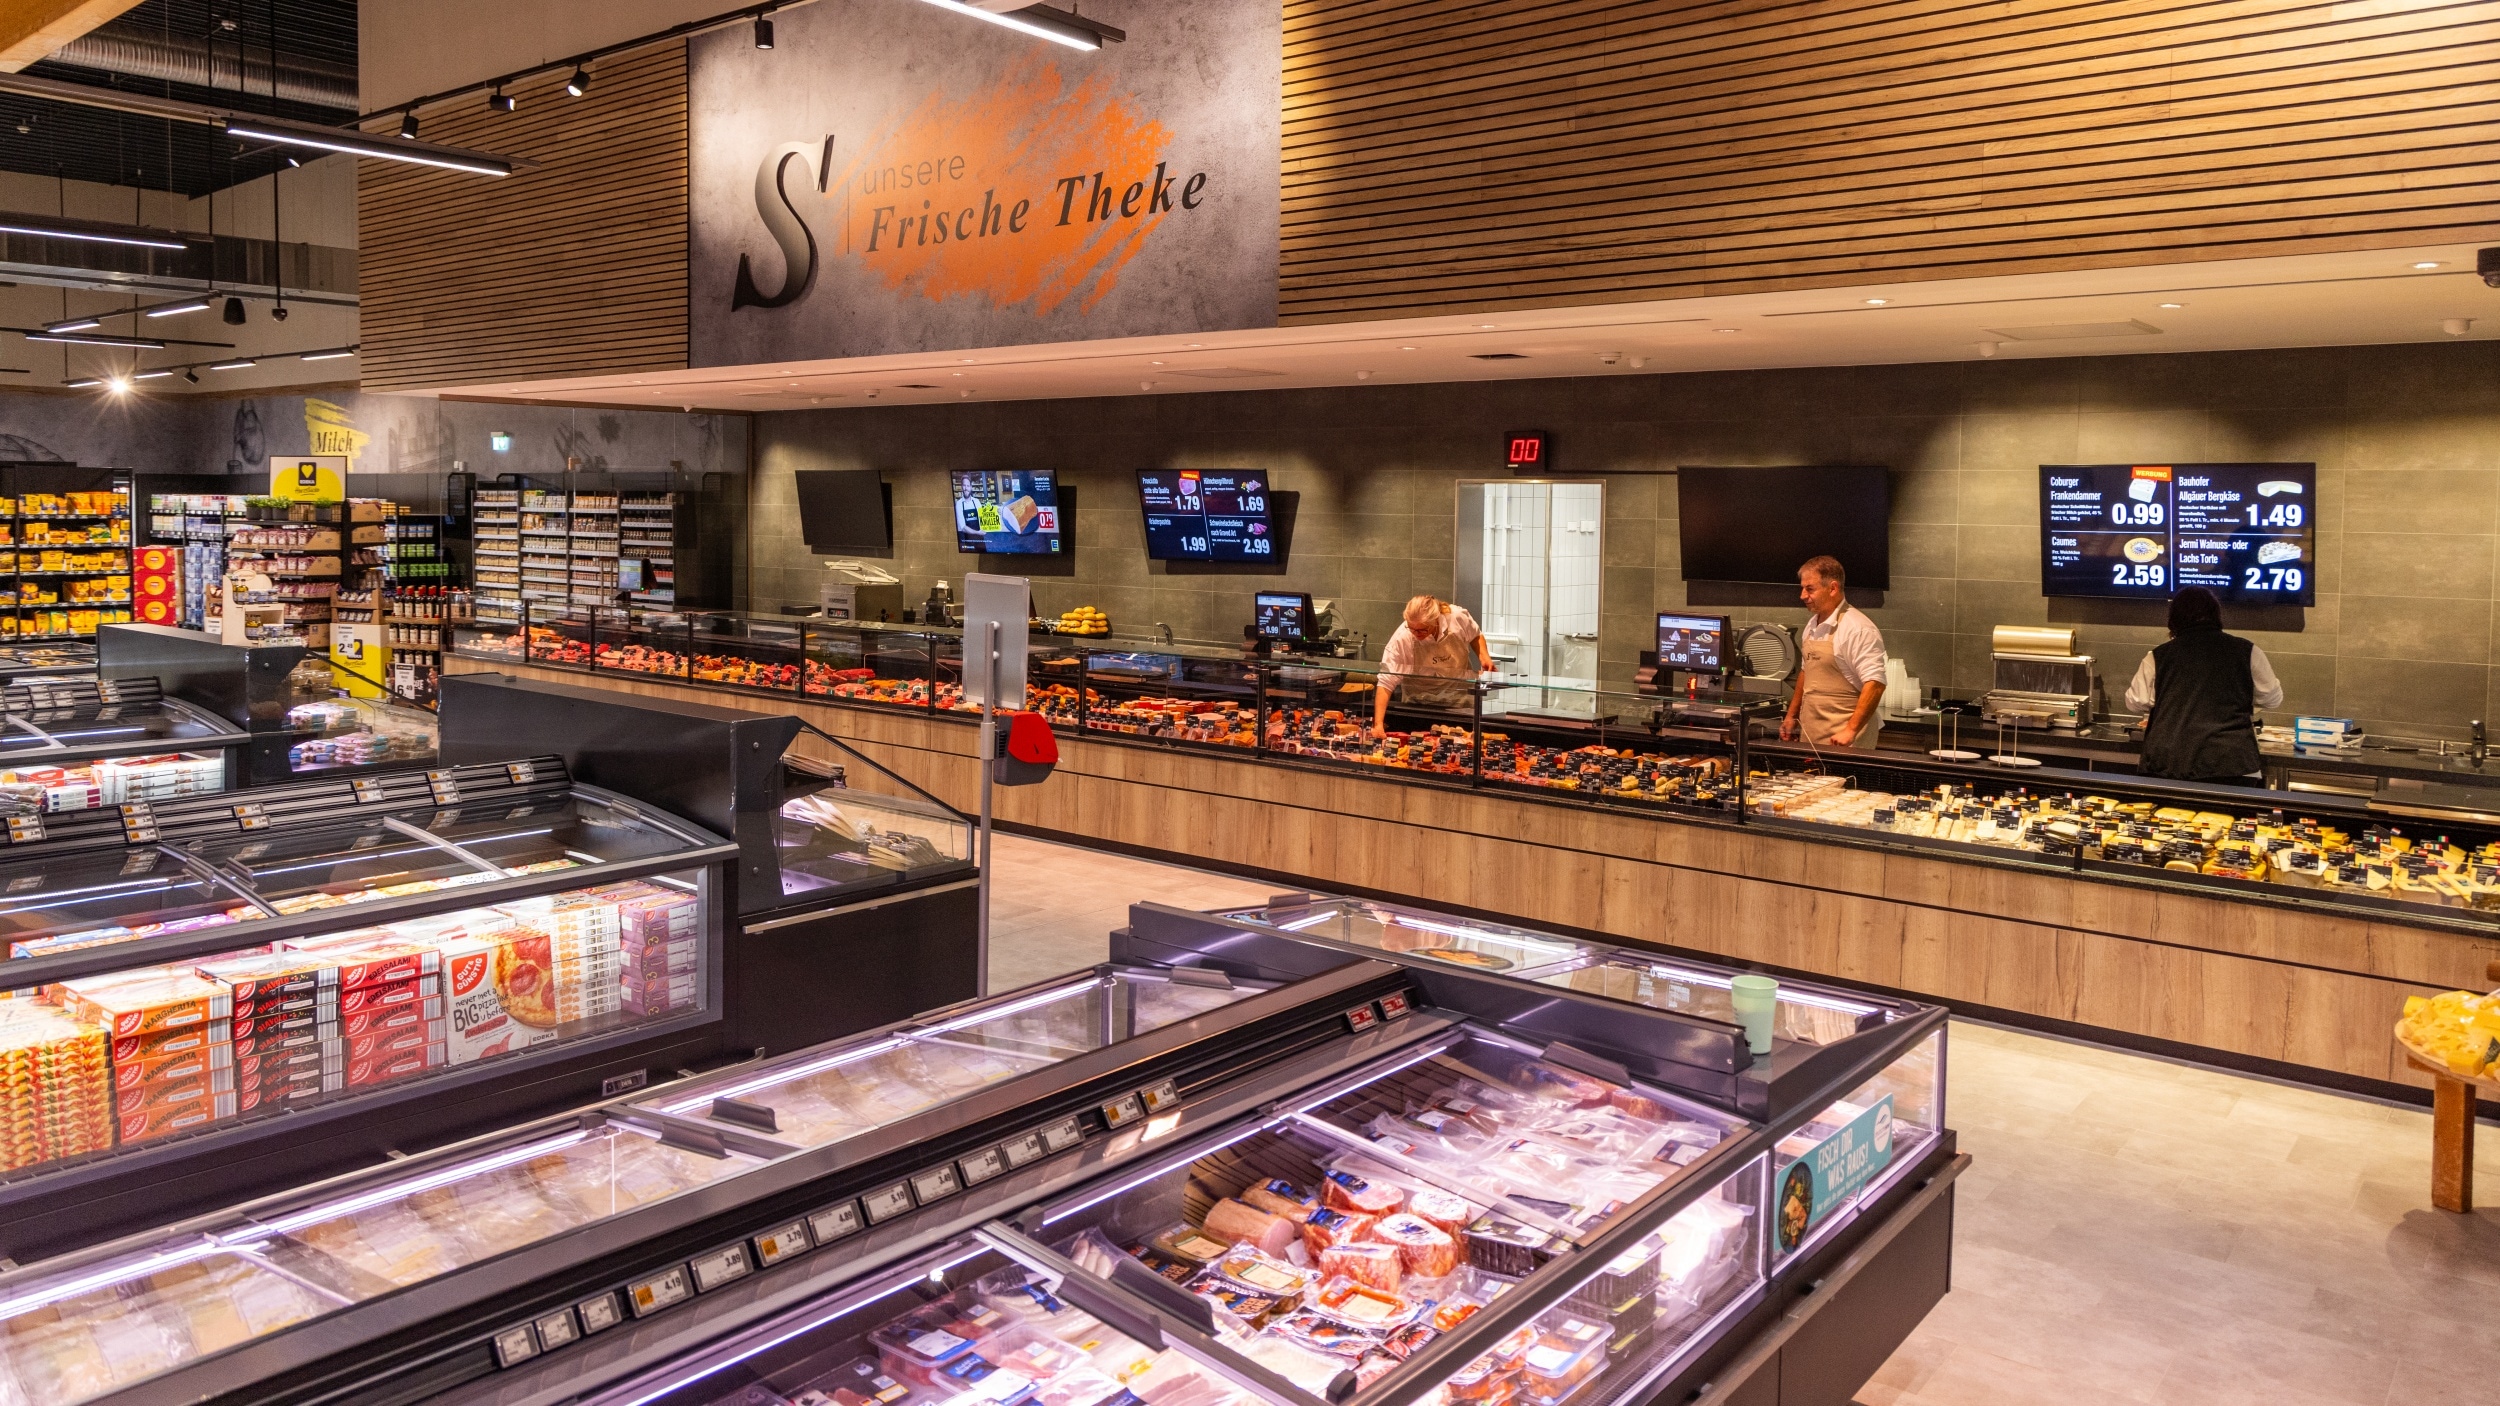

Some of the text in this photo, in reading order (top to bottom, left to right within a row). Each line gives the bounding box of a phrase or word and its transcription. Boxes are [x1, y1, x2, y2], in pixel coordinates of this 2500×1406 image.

[863, 152, 966, 195] unsere
[866, 162, 1207, 253] Frische Theke
[315, 431, 353, 453] Milch
[1510, 439, 1540, 461] 00
[2050, 477, 2079, 488] Coburger
[2136, 470, 2168, 478] WERBUNG
[2179, 476, 2210, 487] Bauhofer
[1175, 495, 1200, 510] 1.79
[1237, 496, 1264, 512] 1.69
[2050, 491, 2102, 501] Frankendammer
[2179, 491, 2240, 503] Allgäuer Bergkäse
[2112, 503, 2164, 524] 0.99
[2246, 504, 2303, 527] 1.49
[1181, 536, 1206, 551] 1.99
[1243, 538, 1270, 554] 2.99
[2052, 536, 2077, 546] Caumes
[2179, 539, 2248, 550] Jermi Walnuss- oder
[2179, 553, 2218, 564] Lachs Torte
[2113, 564, 2165, 586] 2.59
[2245, 568, 2302, 591] 2.79
[1265, 626, 1279, 634] 0.99
[1670, 653, 1687, 662] 0.99
[1700, 655, 1717, 665] 1.49
[368, 957, 411, 980] EDELSALAMI
[457, 957, 483, 990] GÜNSTIG
[258, 976, 290, 996] DIAVOLO
[366, 980, 410, 1004] EDELSALAMI
[257, 995, 288, 1014] DIAVOLO
[455, 995, 477, 1007] never
[478, 989, 491, 1000] met
[143, 1000, 197, 1030] MARGHERITA
[370, 1003, 413, 1028] EDELSALAMI
[453, 1003, 480, 1033] BIG
[478, 999, 497, 1012] pizza
[487, 1004, 511, 1019] before
[257, 1014, 288, 1033] DIAVOLO
[141, 1025, 195, 1056] MARGHERITA
[258, 1032, 289, 1051] DIAVOLO
[532, 1032, 555, 1041] EDEKA
[143, 1051, 197, 1082] MARGHERITA
[263, 1049, 294, 1069] DIAVOLO
[145, 1075, 199, 1106] MARGHERITA
[148, 1100, 202, 1133] MARGHERITA
[1817, 1141, 1839, 1174] FISCH
[1841, 1127, 1853, 1157] DIR
[1828, 1141, 1869, 1192] WAS RAUS!
[890, 1191, 905, 1203] 5.19
[839, 1210, 853, 1223] 4.89
[786, 1229, 802, 1243] 3.79
[724, 1254, 741, 1268] 3.89
[664, 1276, 681, 1290] 4.19
